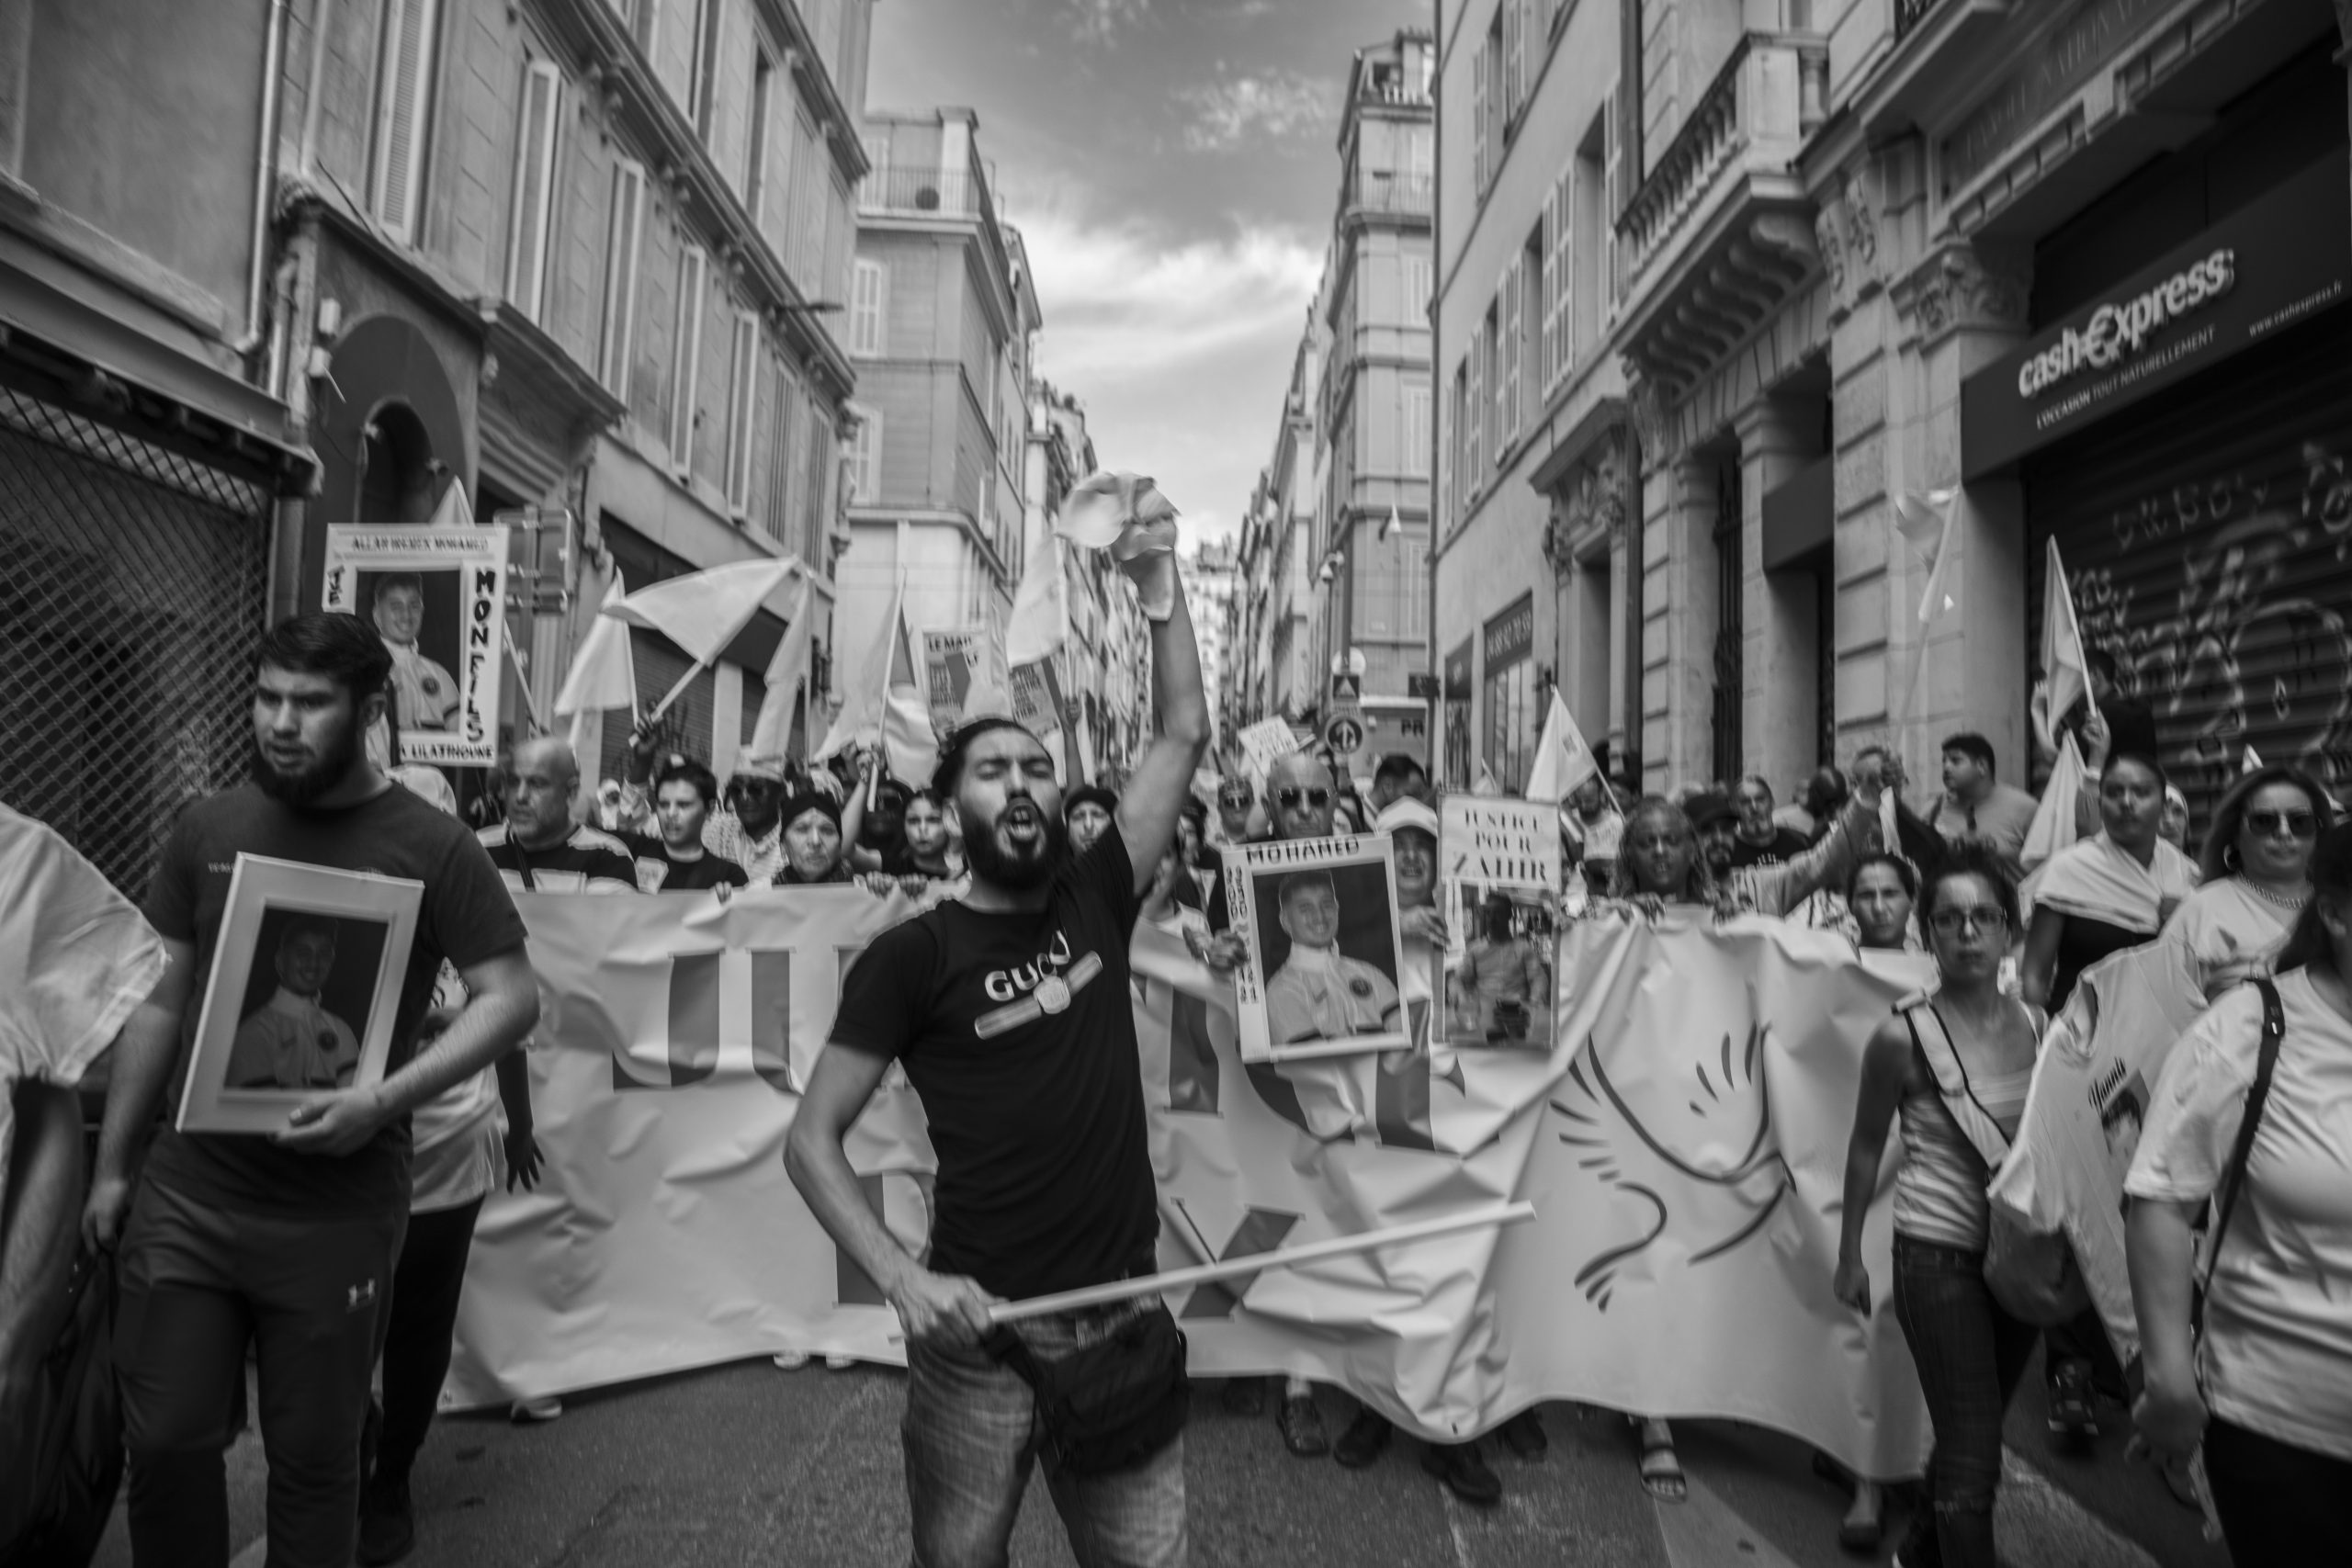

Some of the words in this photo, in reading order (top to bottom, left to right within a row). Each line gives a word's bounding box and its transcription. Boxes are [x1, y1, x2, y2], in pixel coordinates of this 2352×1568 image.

[471, 567, 497, 649] MON
[466, 650, 486, 743] FILS
[1464, 808, 1544, 832] JUSTICE
[1246, 835, 1360, 866] MOHAMED
[1475, 830, 1532, 854] POUR
